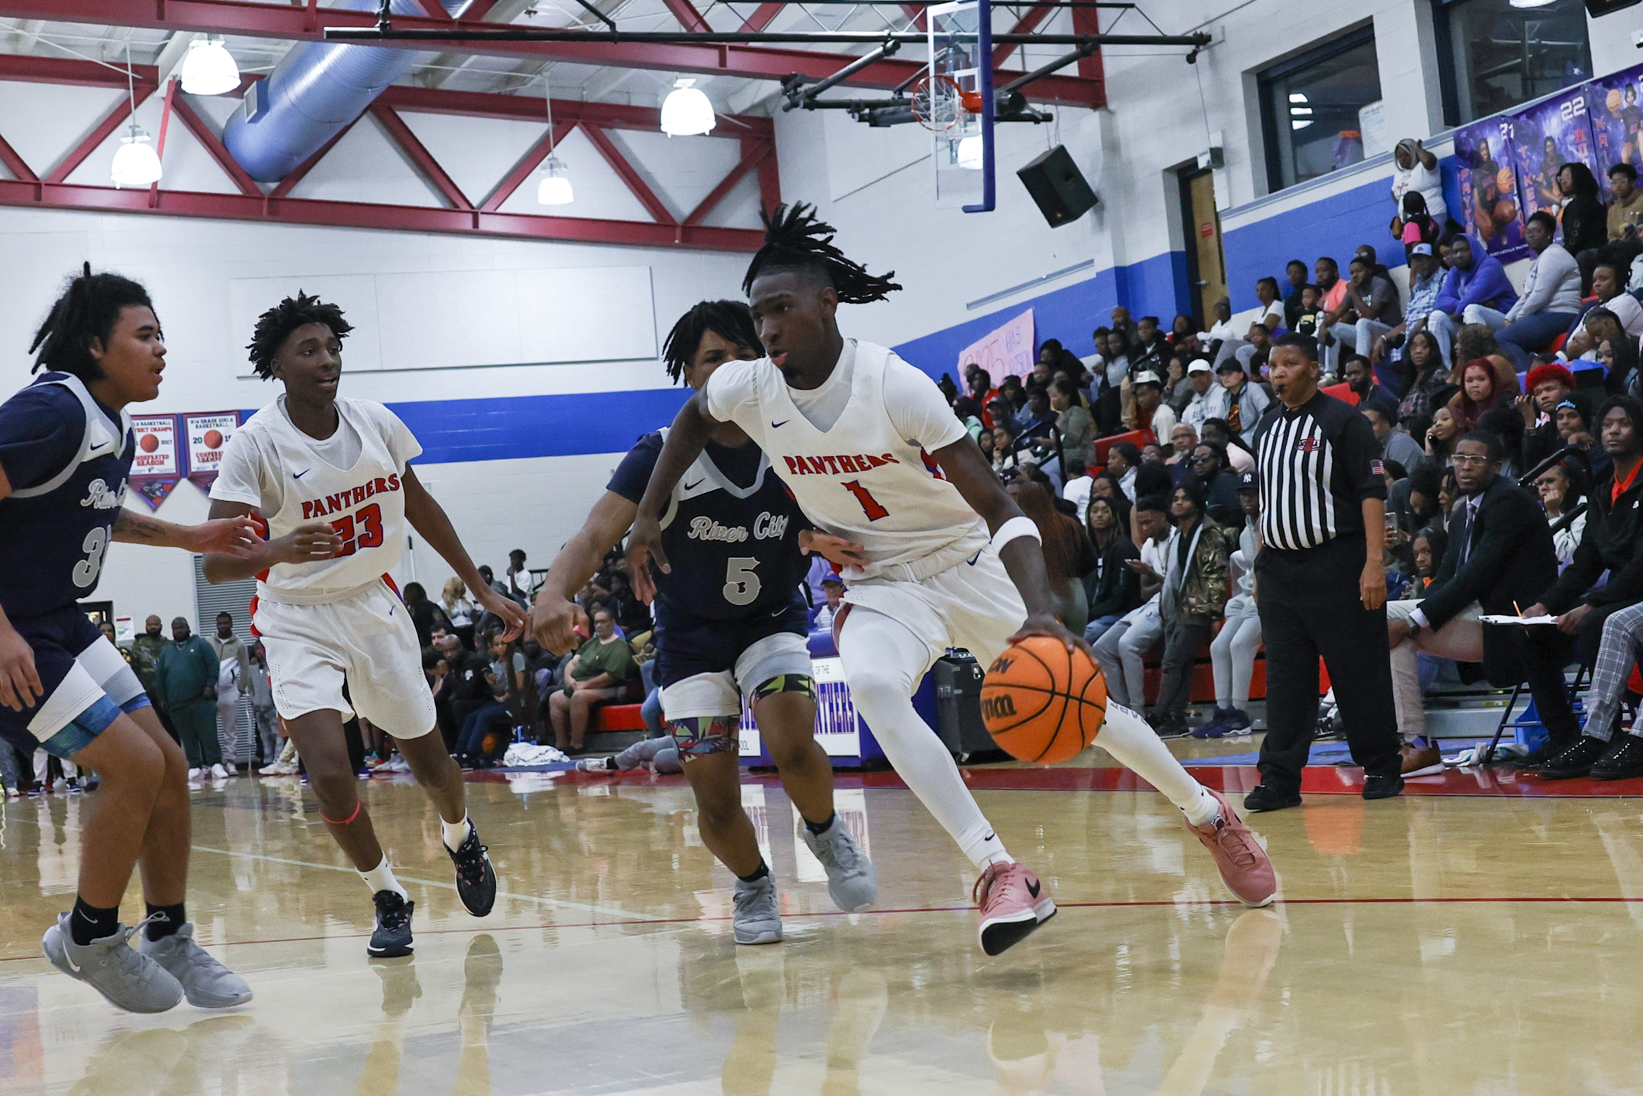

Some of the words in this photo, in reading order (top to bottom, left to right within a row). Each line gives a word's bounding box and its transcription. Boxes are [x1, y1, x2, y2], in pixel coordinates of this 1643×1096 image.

[1560, 96, 1586, 121] 22
[783, 453, 900, 475] PANTHERS
[301, 473, 400, 519] PANTHERS
[840, 479, 890, 522] 1
[330, 503, 384, 559] 23
[687, 516, 748, 543] River
[753, 511, 789, 540] City
[722, 556, 762, 606] 5
